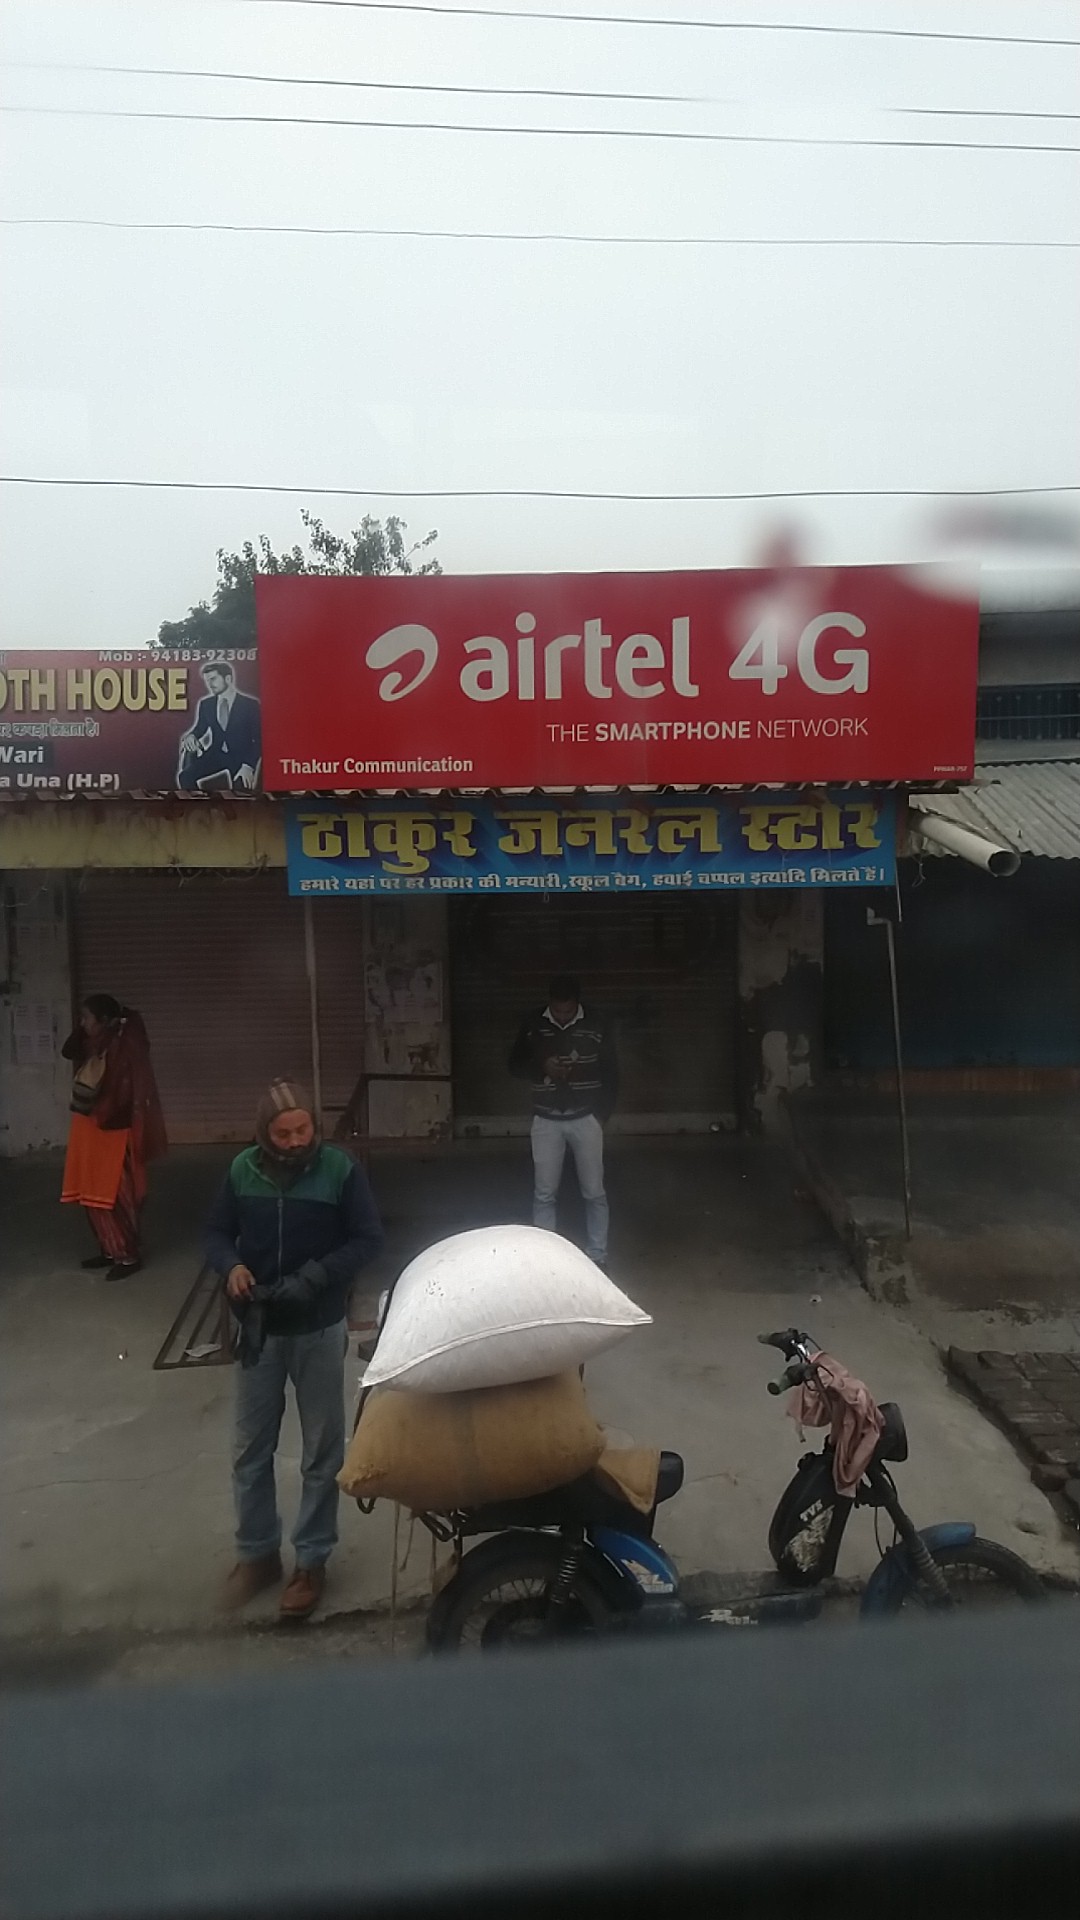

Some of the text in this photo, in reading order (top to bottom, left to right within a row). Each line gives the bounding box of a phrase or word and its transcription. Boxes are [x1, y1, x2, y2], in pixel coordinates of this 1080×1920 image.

[99, 651, 133, 661] Mob
[459, 611, 870, 697] airtel 4G
[0, 667, 188, 711] TH HOUSE
[546, 718, 869, 741] THE SMARTPHONE NETWORK
[280, 755, 474, 774] Thakur Communication
[17, 773, 61, 787] Una
[67, 773, 120, 790] (H.P)
[299, 812, 477, 874] ठाकुर
[495, 809, 722, 856] जनरल
[299, 876, 339, 890] हमारे
[344, 875, 375, 889] यहां
[380, 877, 399, 889] पर
[405, 877, 425, 889] हर
[430, 877, 473, 889] प्रकार
[478, 875, 500, 887] की
[569, 874, 609, 891] स्कूल
[653, 872, 691, 886] हवाई
[698, 872, 745, 885] चप्पल
[751, 869, 805, 885] इत्यादि
[810, 867, 861, 882] मिलते
[799, 1498, 823, 1522] TVS
